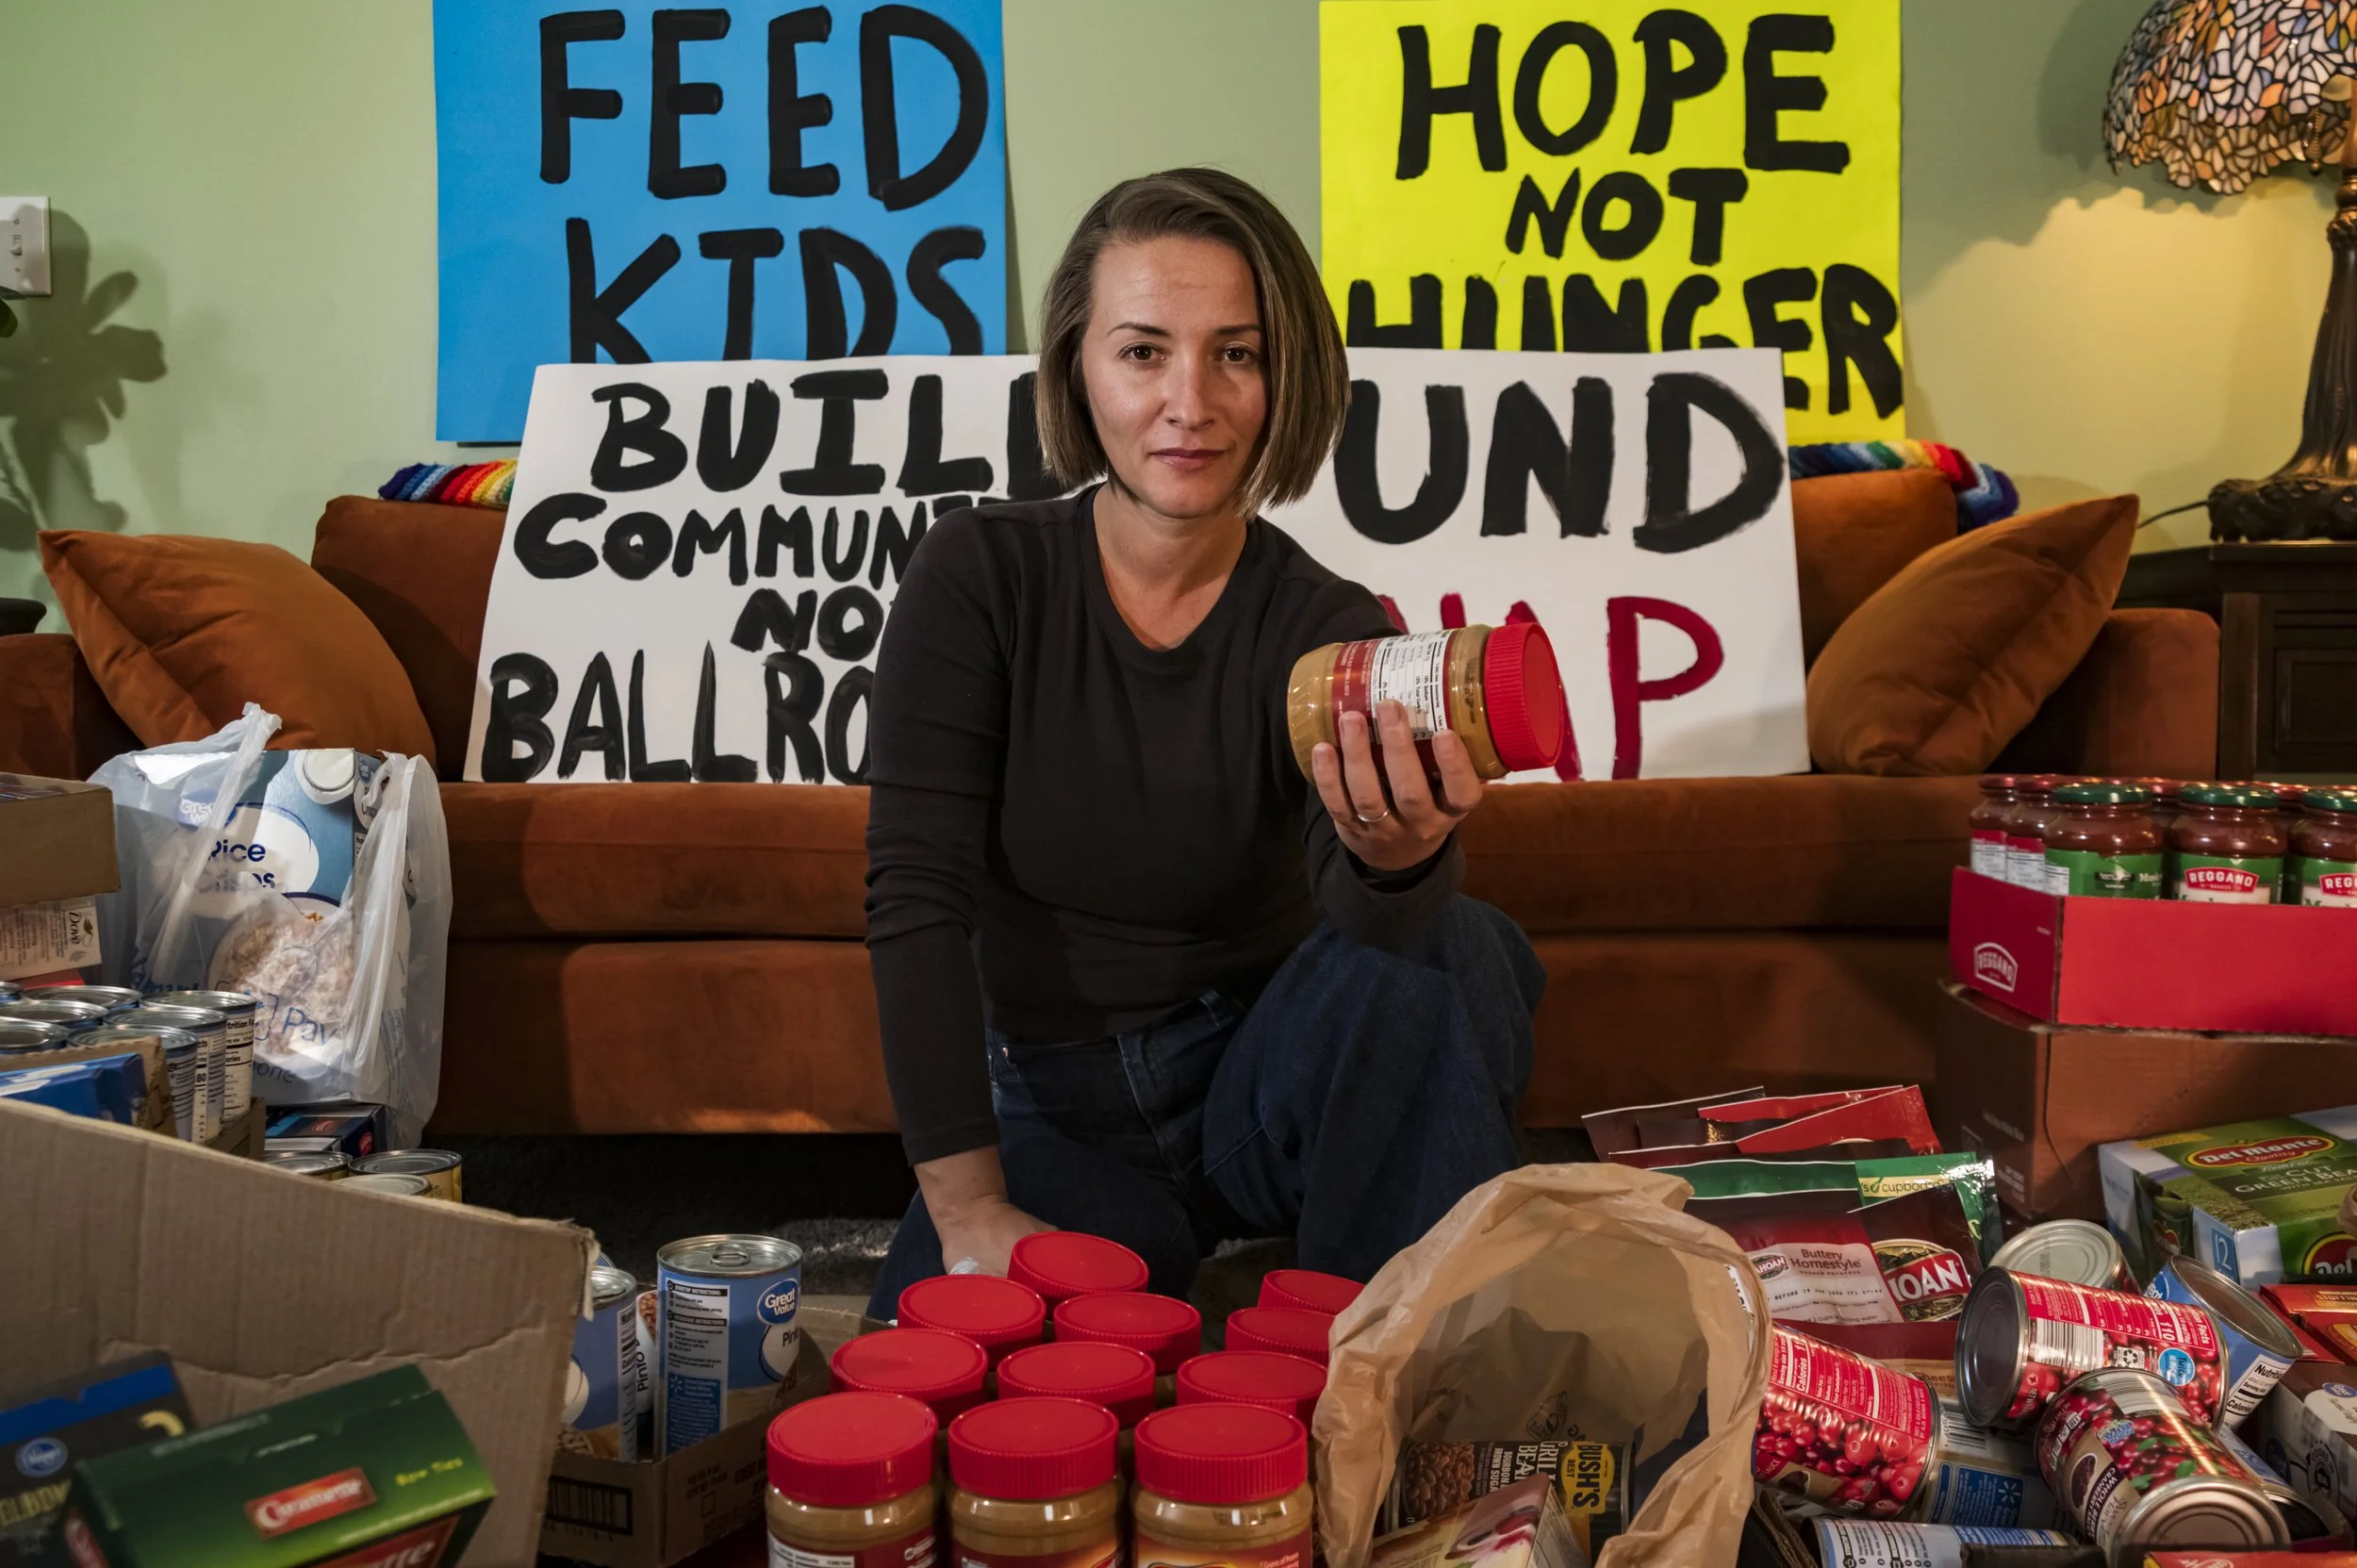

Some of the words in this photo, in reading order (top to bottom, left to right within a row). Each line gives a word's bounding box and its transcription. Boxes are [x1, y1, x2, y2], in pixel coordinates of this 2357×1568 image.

[539, 4, 989, 212] FEED
[1395, 8, 1851, 180] HOPE
[1505, 167, 1749, 267] NOT
[566, 218, 986, 364] KIDS
[590, 368, 1063, 499] BUIL
[1334, 372, 1785, 553] UND
[514, 492, 990, 589] COMMUN
[731, 585, 891, 662] NO
[481, 640, 875, 784] BALLRO
[2189, 870, 2254, 888] REGGANO
[69, 912, 81, 945] Dove
[227, 1021, 248, 1030] trition
[253, 1060, 296, 1084] one
[2199, 1150, 2237, 1164] Del
[2242, 1138, 2322, 1157] Monte
[2234, 1175, 2308, 1194] GREEN
[2286, 1164, 2332, 1178] CUT
[1789, 1258, 1862, 1271] Homestyle
[1801, 1249, 1843, 1261] Buttery
[2216, 1235, 2233, 1270] 12
[765, 1288, 796, 1310] Great
[773, 1301, 796, 1317] Value
[2159, 1321, 2174, 1341] 110
[2200, 1325, 2210, 1344] Facts
[635, 1352, 649, 1393] Pinto
[1796, 1358, 1808, 1391] Calories
[1492, 1448, 1501, 1470] BROWN
[1501, 1451, 1513, 1482] BOURBON
[1536, 1441, 1558, 1482] GRIL
[1490, 1470, 1500, 1493] SUGA
[1573, 1444, 1603, 1508] BUSH'S
[2098, 1477, 2118, 1508] WHOLE
